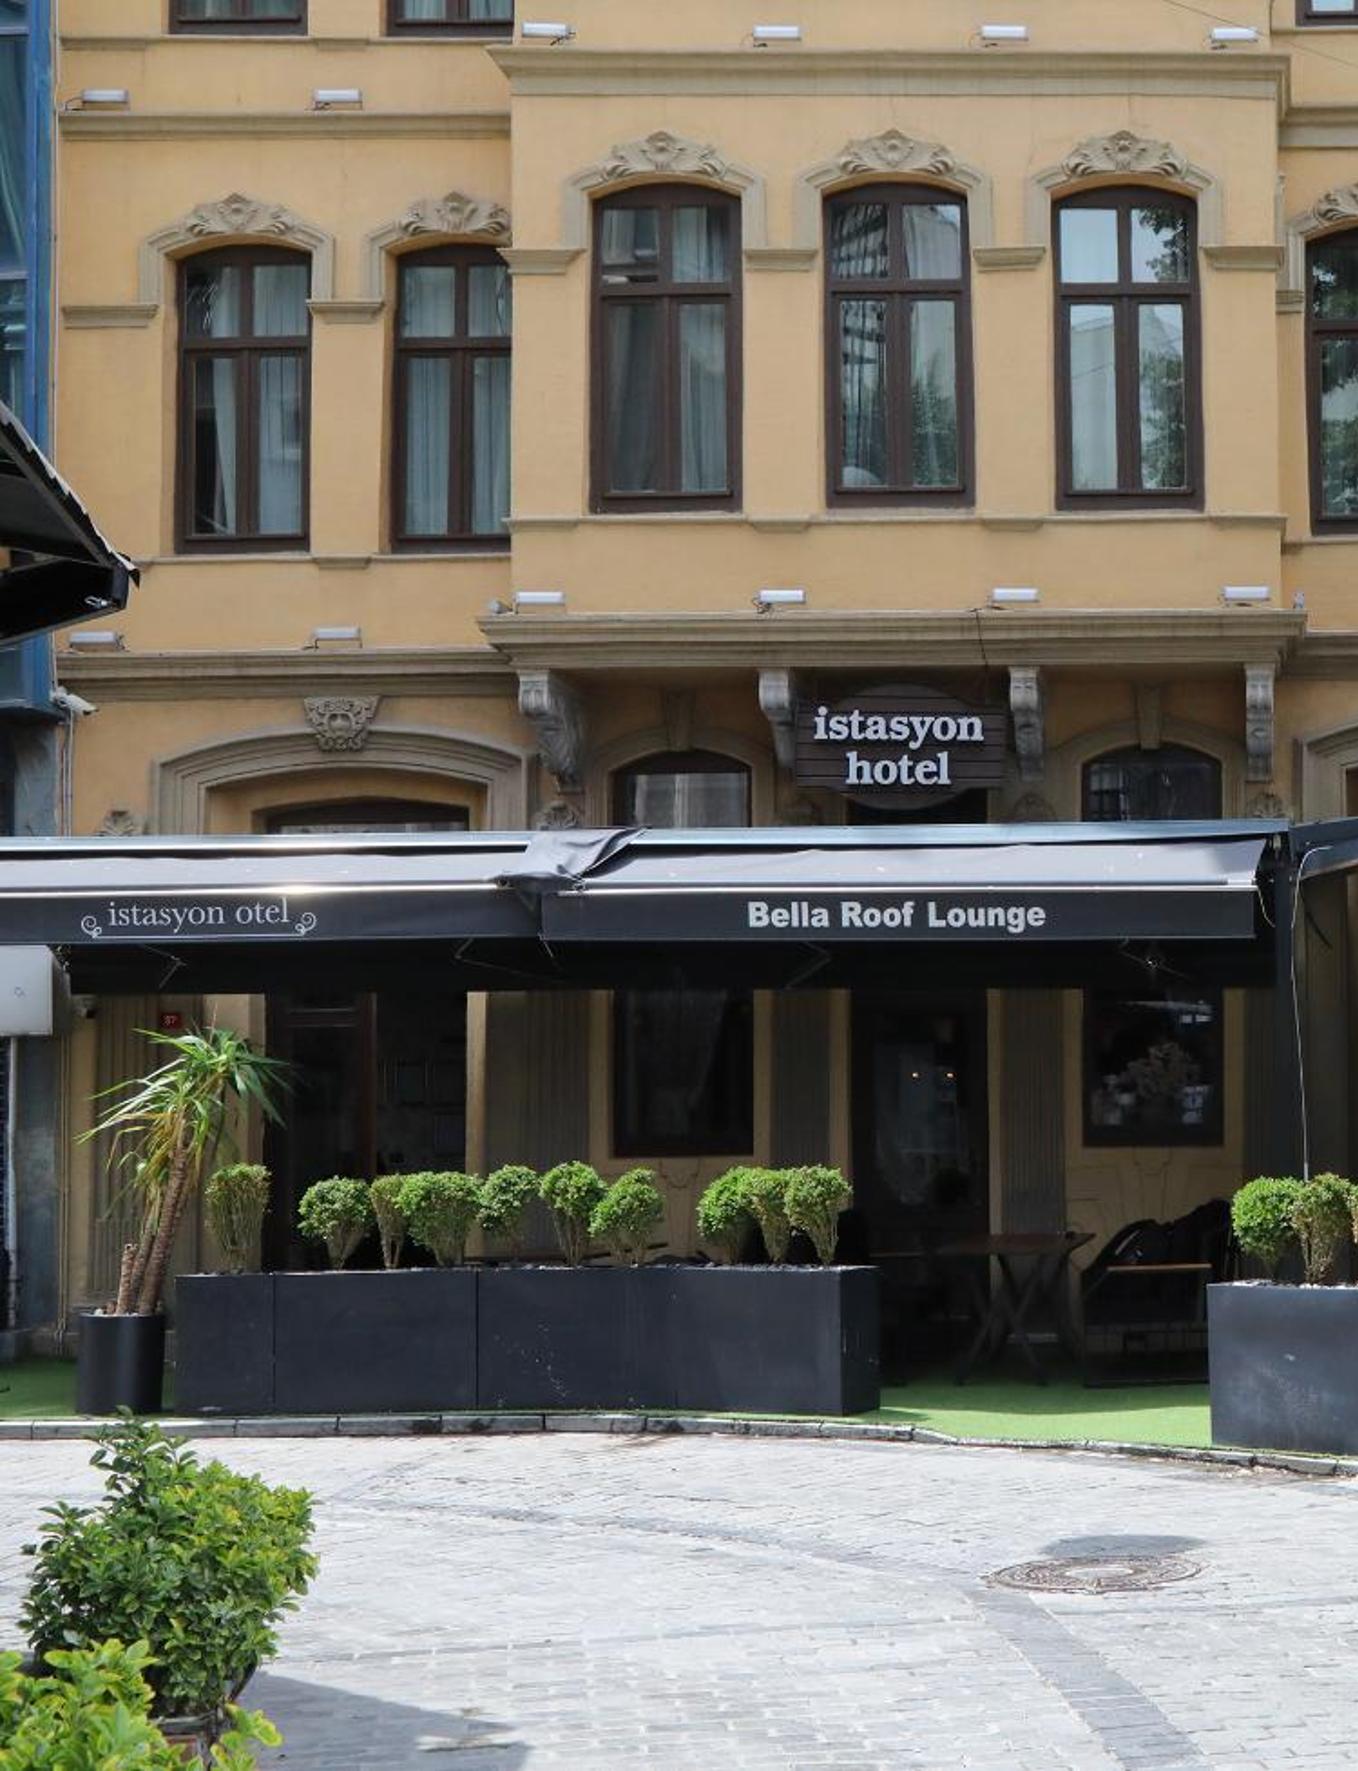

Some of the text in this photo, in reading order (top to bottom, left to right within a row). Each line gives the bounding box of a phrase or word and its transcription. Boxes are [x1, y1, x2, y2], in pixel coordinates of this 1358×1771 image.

[813, 706, 984, 749] istasyon
[845, 751, 951, 785] hotel
[108, 896, 290, 932] istasyon otel
[748, 901, 1046, 933] Bella Roof Lounge
